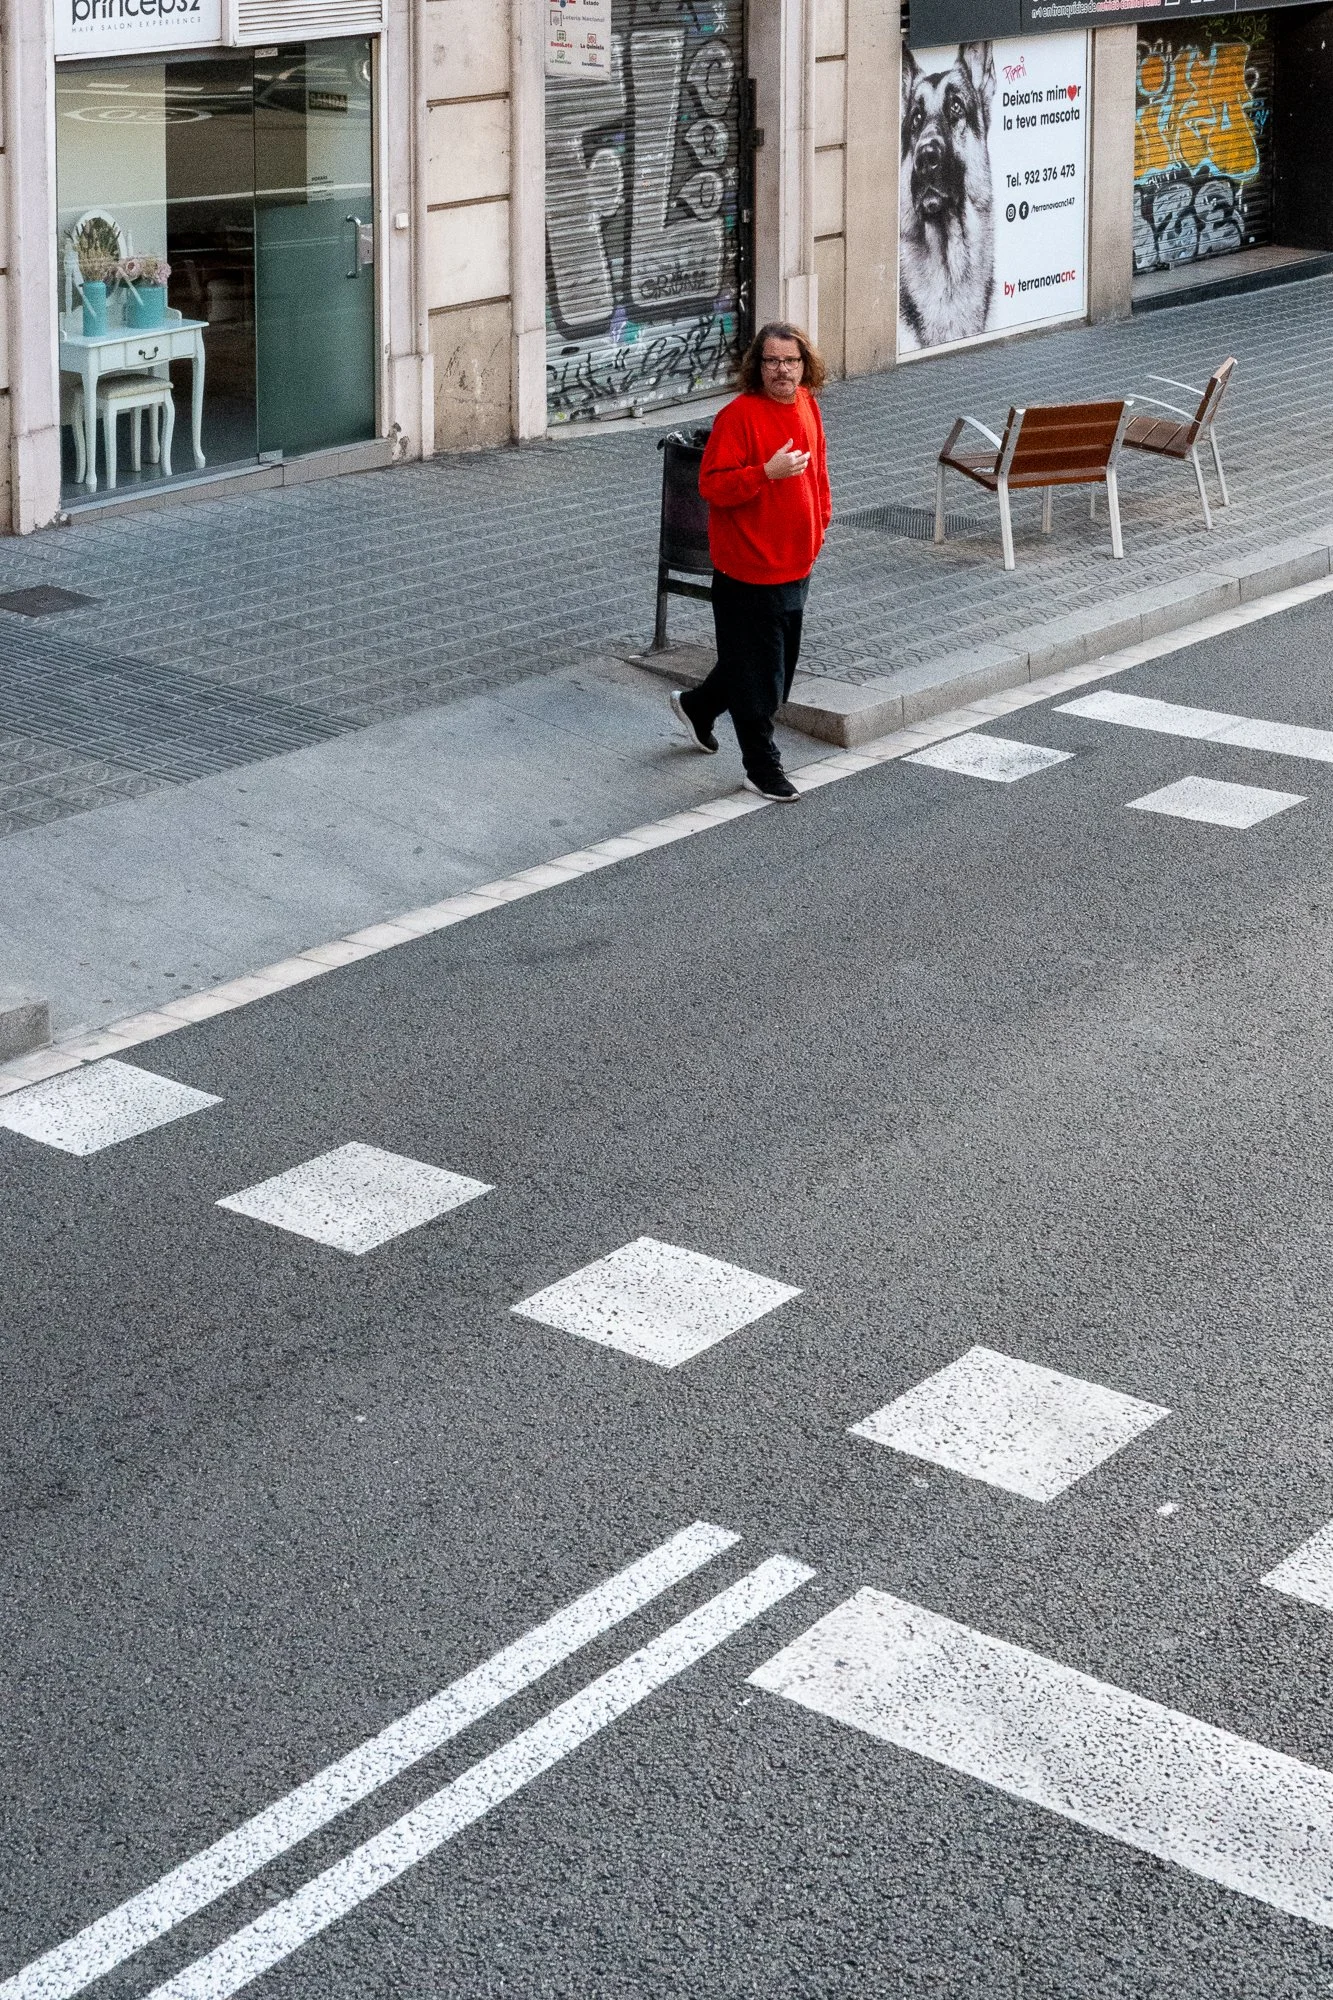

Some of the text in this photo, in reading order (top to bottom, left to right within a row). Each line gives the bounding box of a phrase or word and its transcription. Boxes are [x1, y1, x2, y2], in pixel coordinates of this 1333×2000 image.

[101, 23, 132, 31] SALON
[139, 16, 201, 28] EXPERIENCE
[1002, 90, 1043, 107] Deixa'ns
[1003, 107, 1080, 131] la teva mascota
[1006, 163, 1076, 188] Tel. 932 376 473
[1031, 197, 1075, 213] /terranovacnc147
[1004, 269, 1076, 298] by terranovacnc
